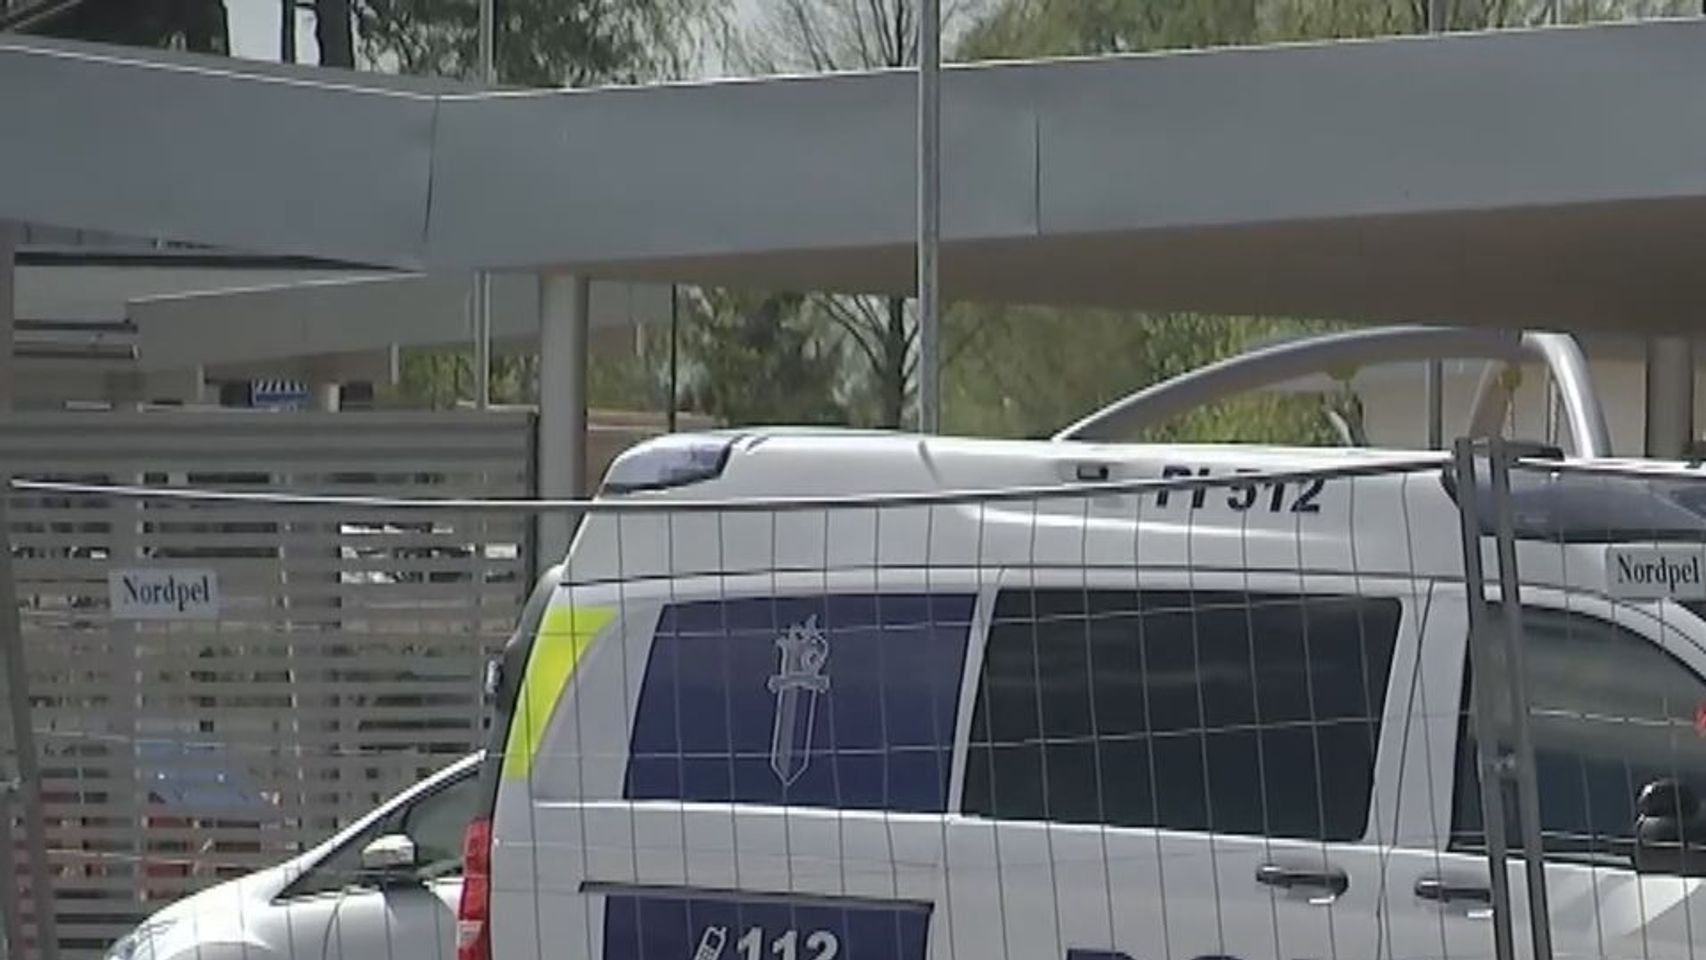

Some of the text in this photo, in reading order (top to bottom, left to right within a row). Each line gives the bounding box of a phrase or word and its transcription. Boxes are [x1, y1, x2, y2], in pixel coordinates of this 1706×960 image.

[1227, 467, 1326, 513] 512
[1617, 552, 1700, 593] Nordpel
[122, 575, 211, 612] Nordpel
